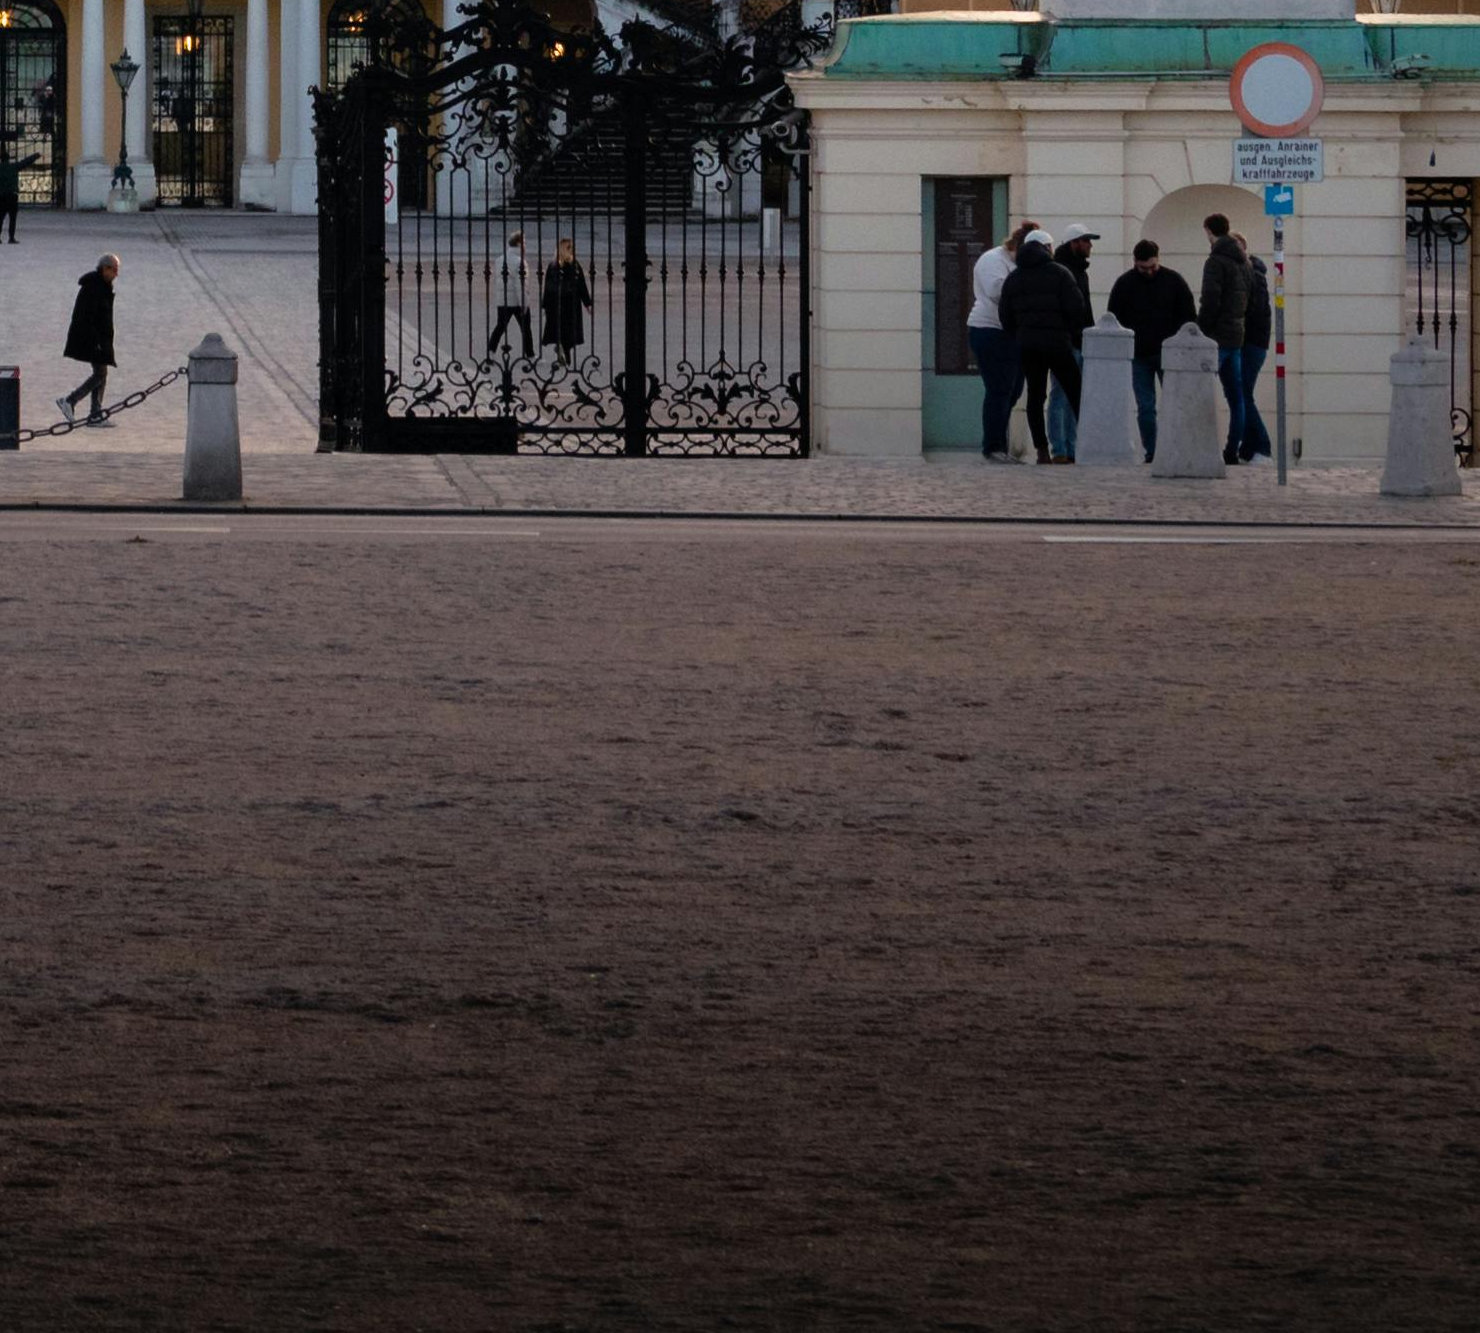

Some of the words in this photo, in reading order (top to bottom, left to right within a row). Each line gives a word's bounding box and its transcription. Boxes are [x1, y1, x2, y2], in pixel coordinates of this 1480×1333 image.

[1278, 141, 1318, 151] Anrainer
[1240, 155, 1257, 166] und
[1261, 155, 1317, 168] Ausgleichs-
[1242, 168, 1315, 181] kraftfahrzeuge
